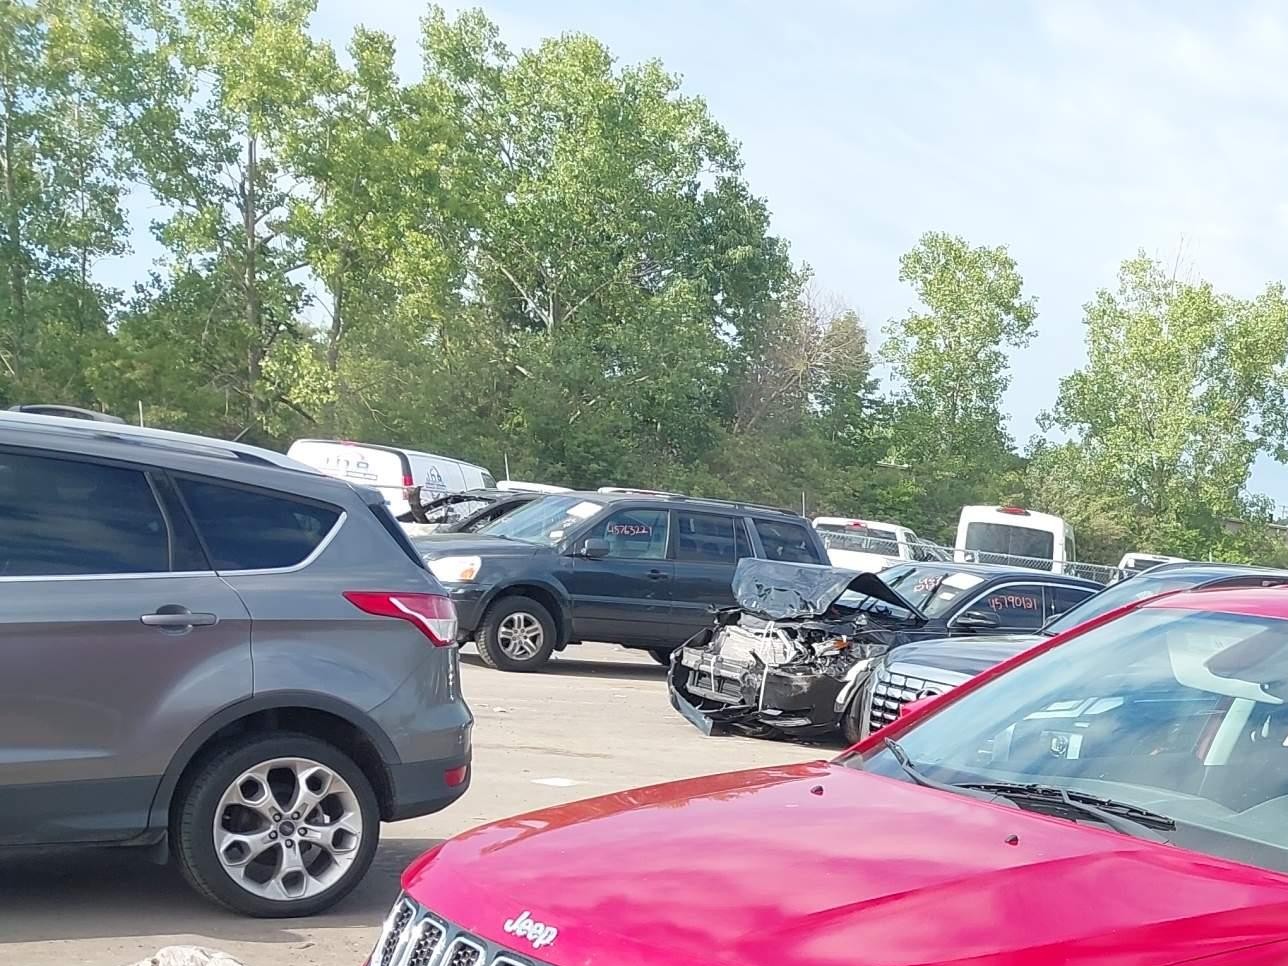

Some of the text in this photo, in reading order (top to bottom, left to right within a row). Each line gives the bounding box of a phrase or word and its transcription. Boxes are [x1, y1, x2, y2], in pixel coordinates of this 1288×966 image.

[606, 521, 653, 537] 45763221
[988, 595, 1038, 611] 45790121
[503, 910, 558, 949] Jeep
